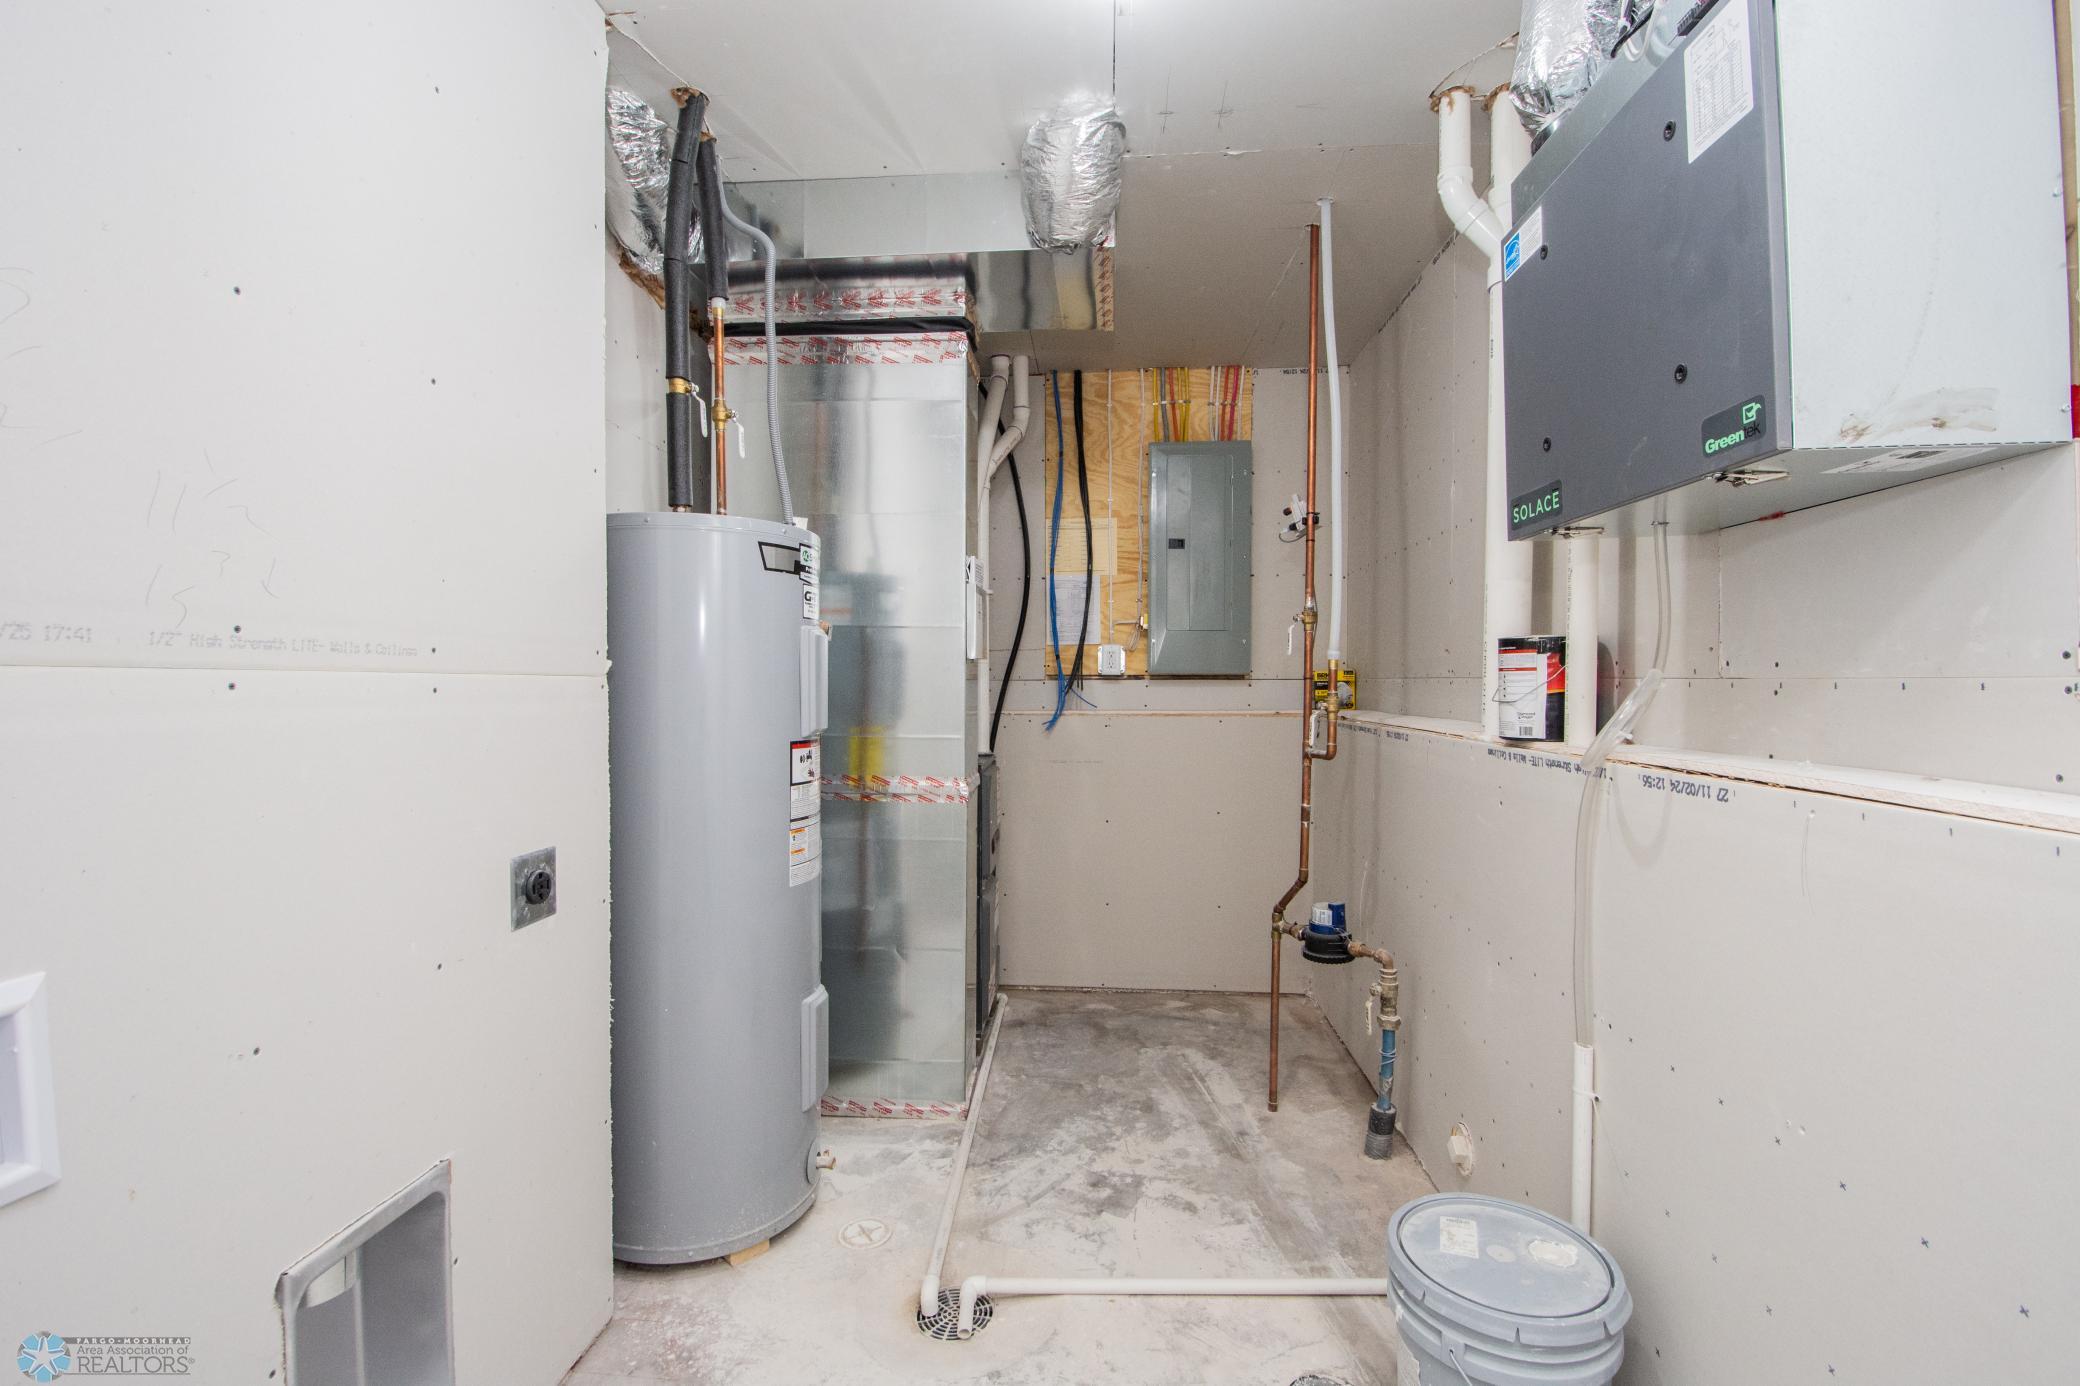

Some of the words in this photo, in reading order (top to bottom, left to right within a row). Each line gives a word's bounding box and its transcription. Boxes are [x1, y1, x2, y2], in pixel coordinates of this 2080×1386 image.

[1705, 420, 1761, 454] Greentek
[1513, 491, 1560, 523] SOLACE
[44, 625, 92, 643] 17:41
[1642, 774, 1665, 790] 12:56
[1670, 779, 1711, 799] 11/02/24
